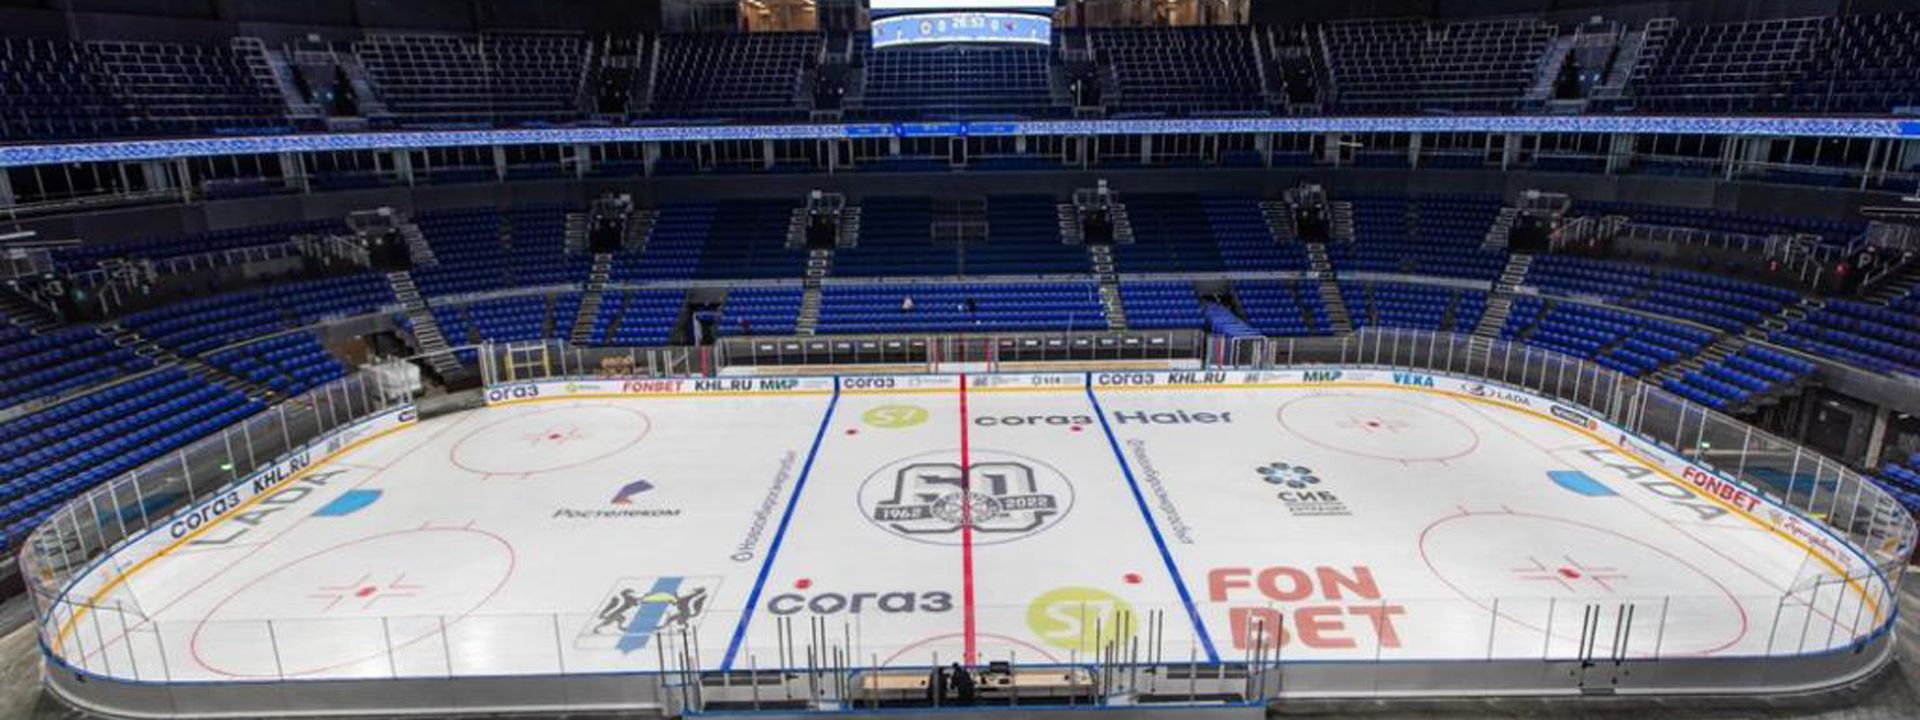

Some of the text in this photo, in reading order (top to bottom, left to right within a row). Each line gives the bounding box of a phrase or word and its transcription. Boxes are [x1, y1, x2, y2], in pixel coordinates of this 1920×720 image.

[843, 377, 895, 389] согаз
[1098, 373, 1155, 386] согаз
[1167, 372, 1226, 384] KHL.RU
[1303, 371, 1343, 382] МИР
[1392, 373, 1436, 388] VEKA
[622, 380, 684, 393] FONBET
[694, 380, 752, 391] KHL.RU
[759, 380, 799, 390] МИР
[974, 413, 1094, 428] согаз
[1113, 409, 1232, 425] Haier
[253, 451, 311, 494] KHL.RU
[1682, 465, 1763, 512] FONBET
[170, 492, 241, 539] согаз
[1207, 565, 1381, 602] FON
[767, 591, 953, 615] согаз
[1228, 605, 1405, 650] BET
